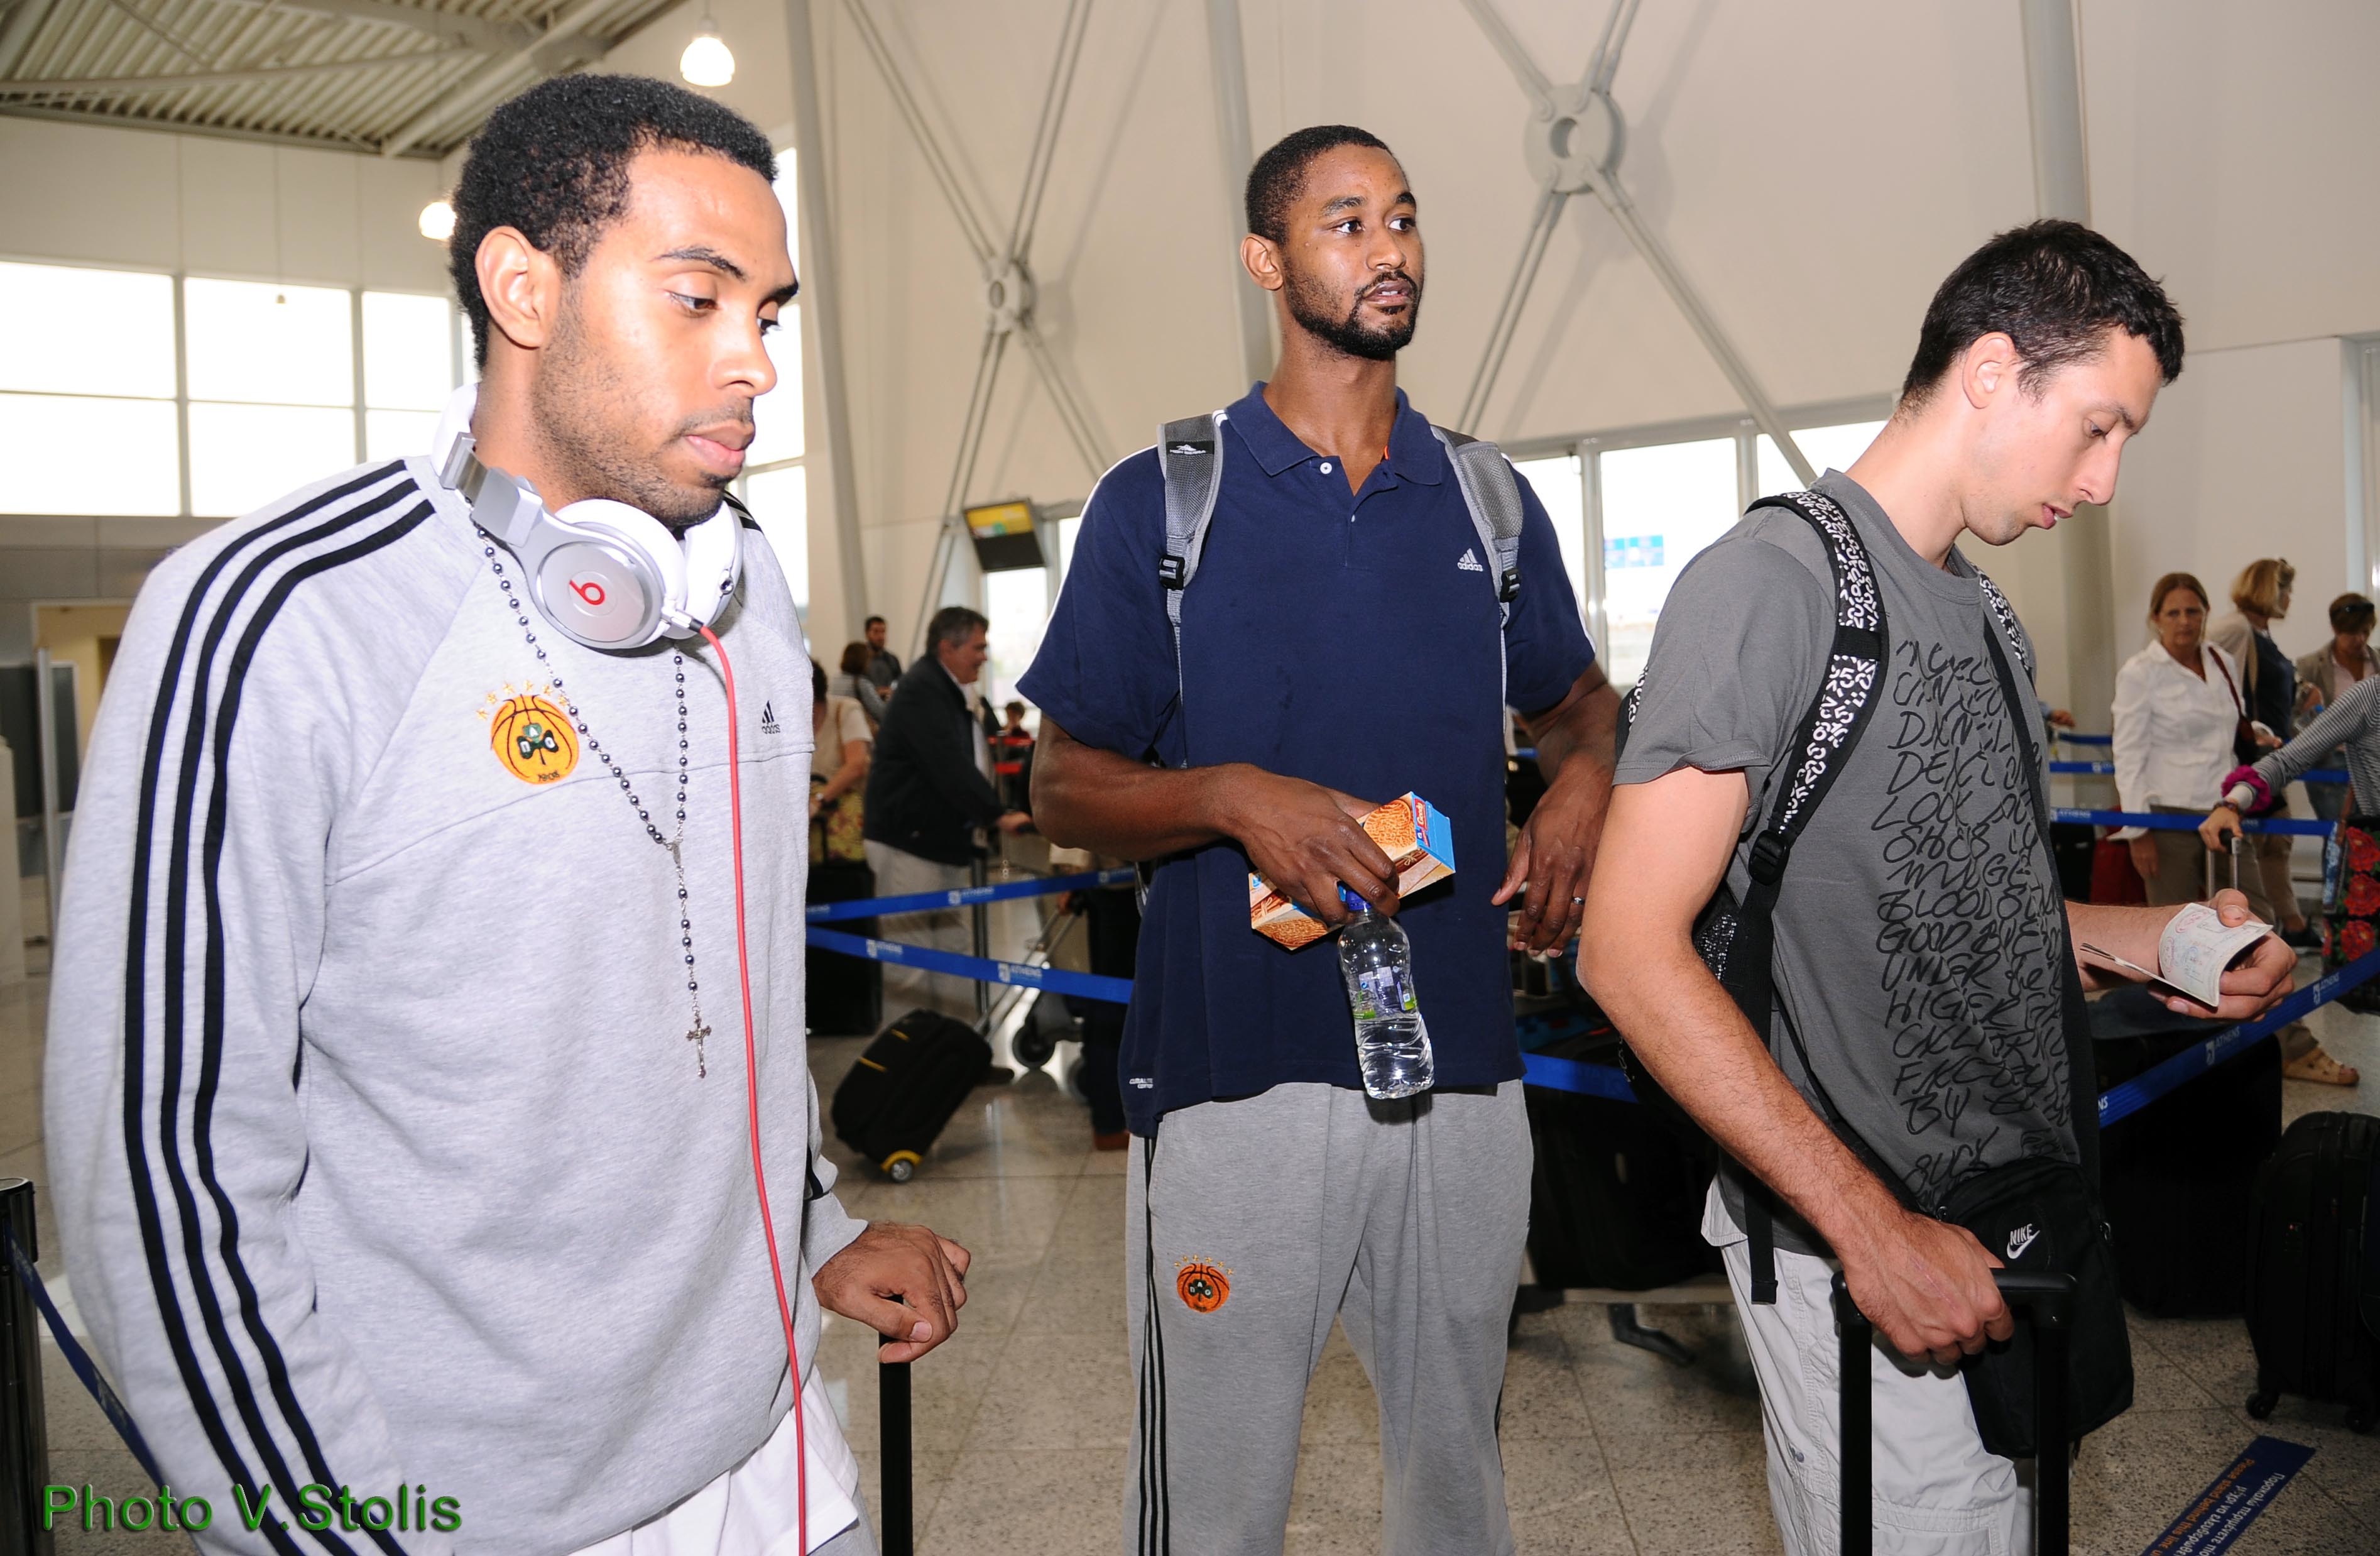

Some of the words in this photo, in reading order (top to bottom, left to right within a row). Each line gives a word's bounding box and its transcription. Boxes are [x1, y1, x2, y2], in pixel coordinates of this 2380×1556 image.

[2010, 1223, 2033, 1246] NIKE
[2227, 1459, 2255, 1479] Please
[2208, 1479, 2232, 1499] stand
[2246, 1472, 2286, 1507] Παρακαλώ
[2186, 1498, 2216, 1523] behind
[2215, 1504, 2232, 1514] να
[2172, 1521, 2193, 1535] this
[2211, 1506, 2251, 1544] περιμένετε
